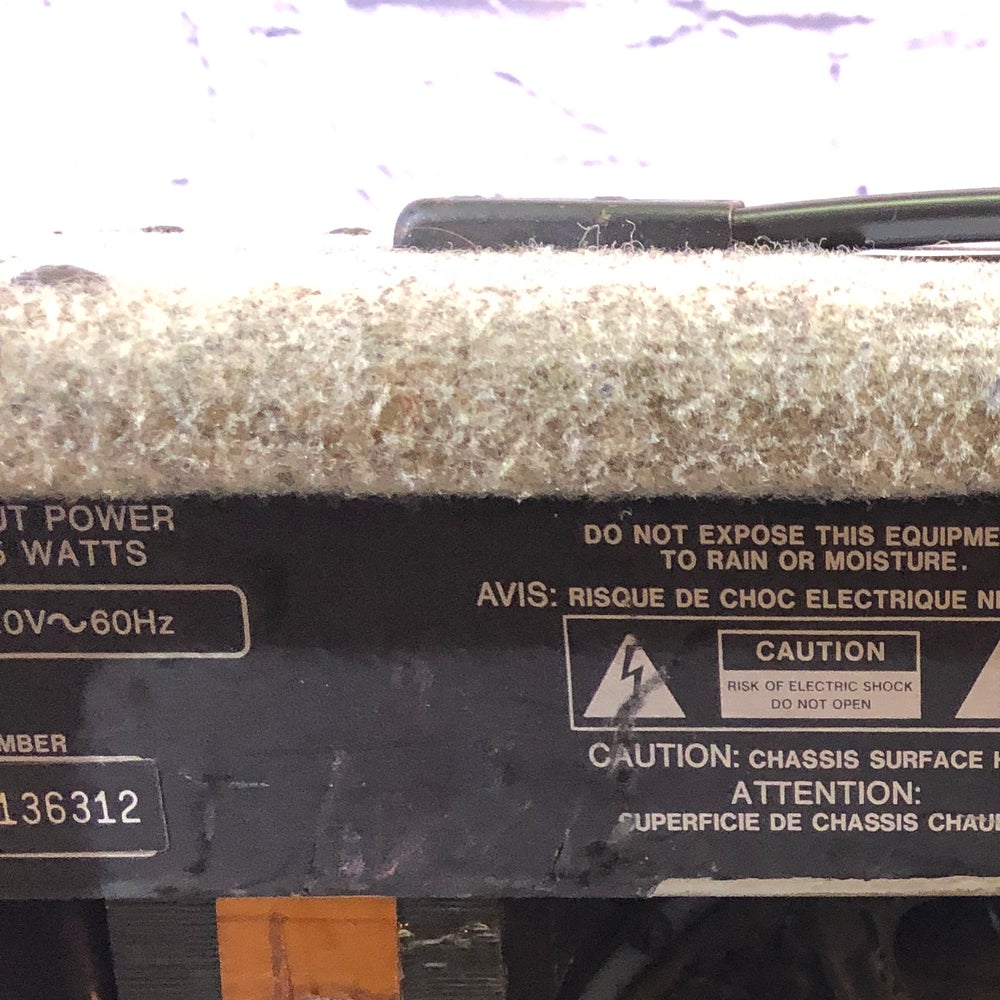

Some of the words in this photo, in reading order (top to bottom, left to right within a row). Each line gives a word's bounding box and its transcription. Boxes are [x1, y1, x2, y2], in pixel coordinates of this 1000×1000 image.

[44, 504, 175, 532] POWER
[583, 523, 623, 546] DO
[633, 523, 689, 546] NOT
[699, 524, 805, 546] EXPOSE
[815, 524, 876, 548] THIS
[20, 538, 148, 567] WATTS
[660, 549, 697, 571] TO
[707, 549, 769, 571] RAIN
[779, 549, 815, 571] OR
[825, 550, 969, 572] MOISTURE.
[476, 580, 558, 609] AVIS:
[568, 587, 666, 609] RISQUE
[676, 588, 709, 609] DE
[719, 588, 796, 610] CHOC
[805, 589, 967, 611] ELECTRIQUE
[755, 640, 886, 663] CAUTION
[727, 680, 760, 692] RISK
[764, 680, 784, 692] OF
[789, 680, 858, 692] ELECTRIC
[863, 680, 913, 692] SHOCK
[771, 698, 793, 710] DO
[797, 698, 827, 710] NOT
[832, 698, 872, 710] OPEN
[588, 742, 740, 768] CAUTION:
[748, 750, 860, 769] CHASSIS
[870, 750, 983, 769] SURFACE
[730, 780, 922, 805] ATTENTION:
[0, 790, 142, 825] 136312
[769, 812, 803, 831] DE
[811, 813, 919, 831] CHASSIS
